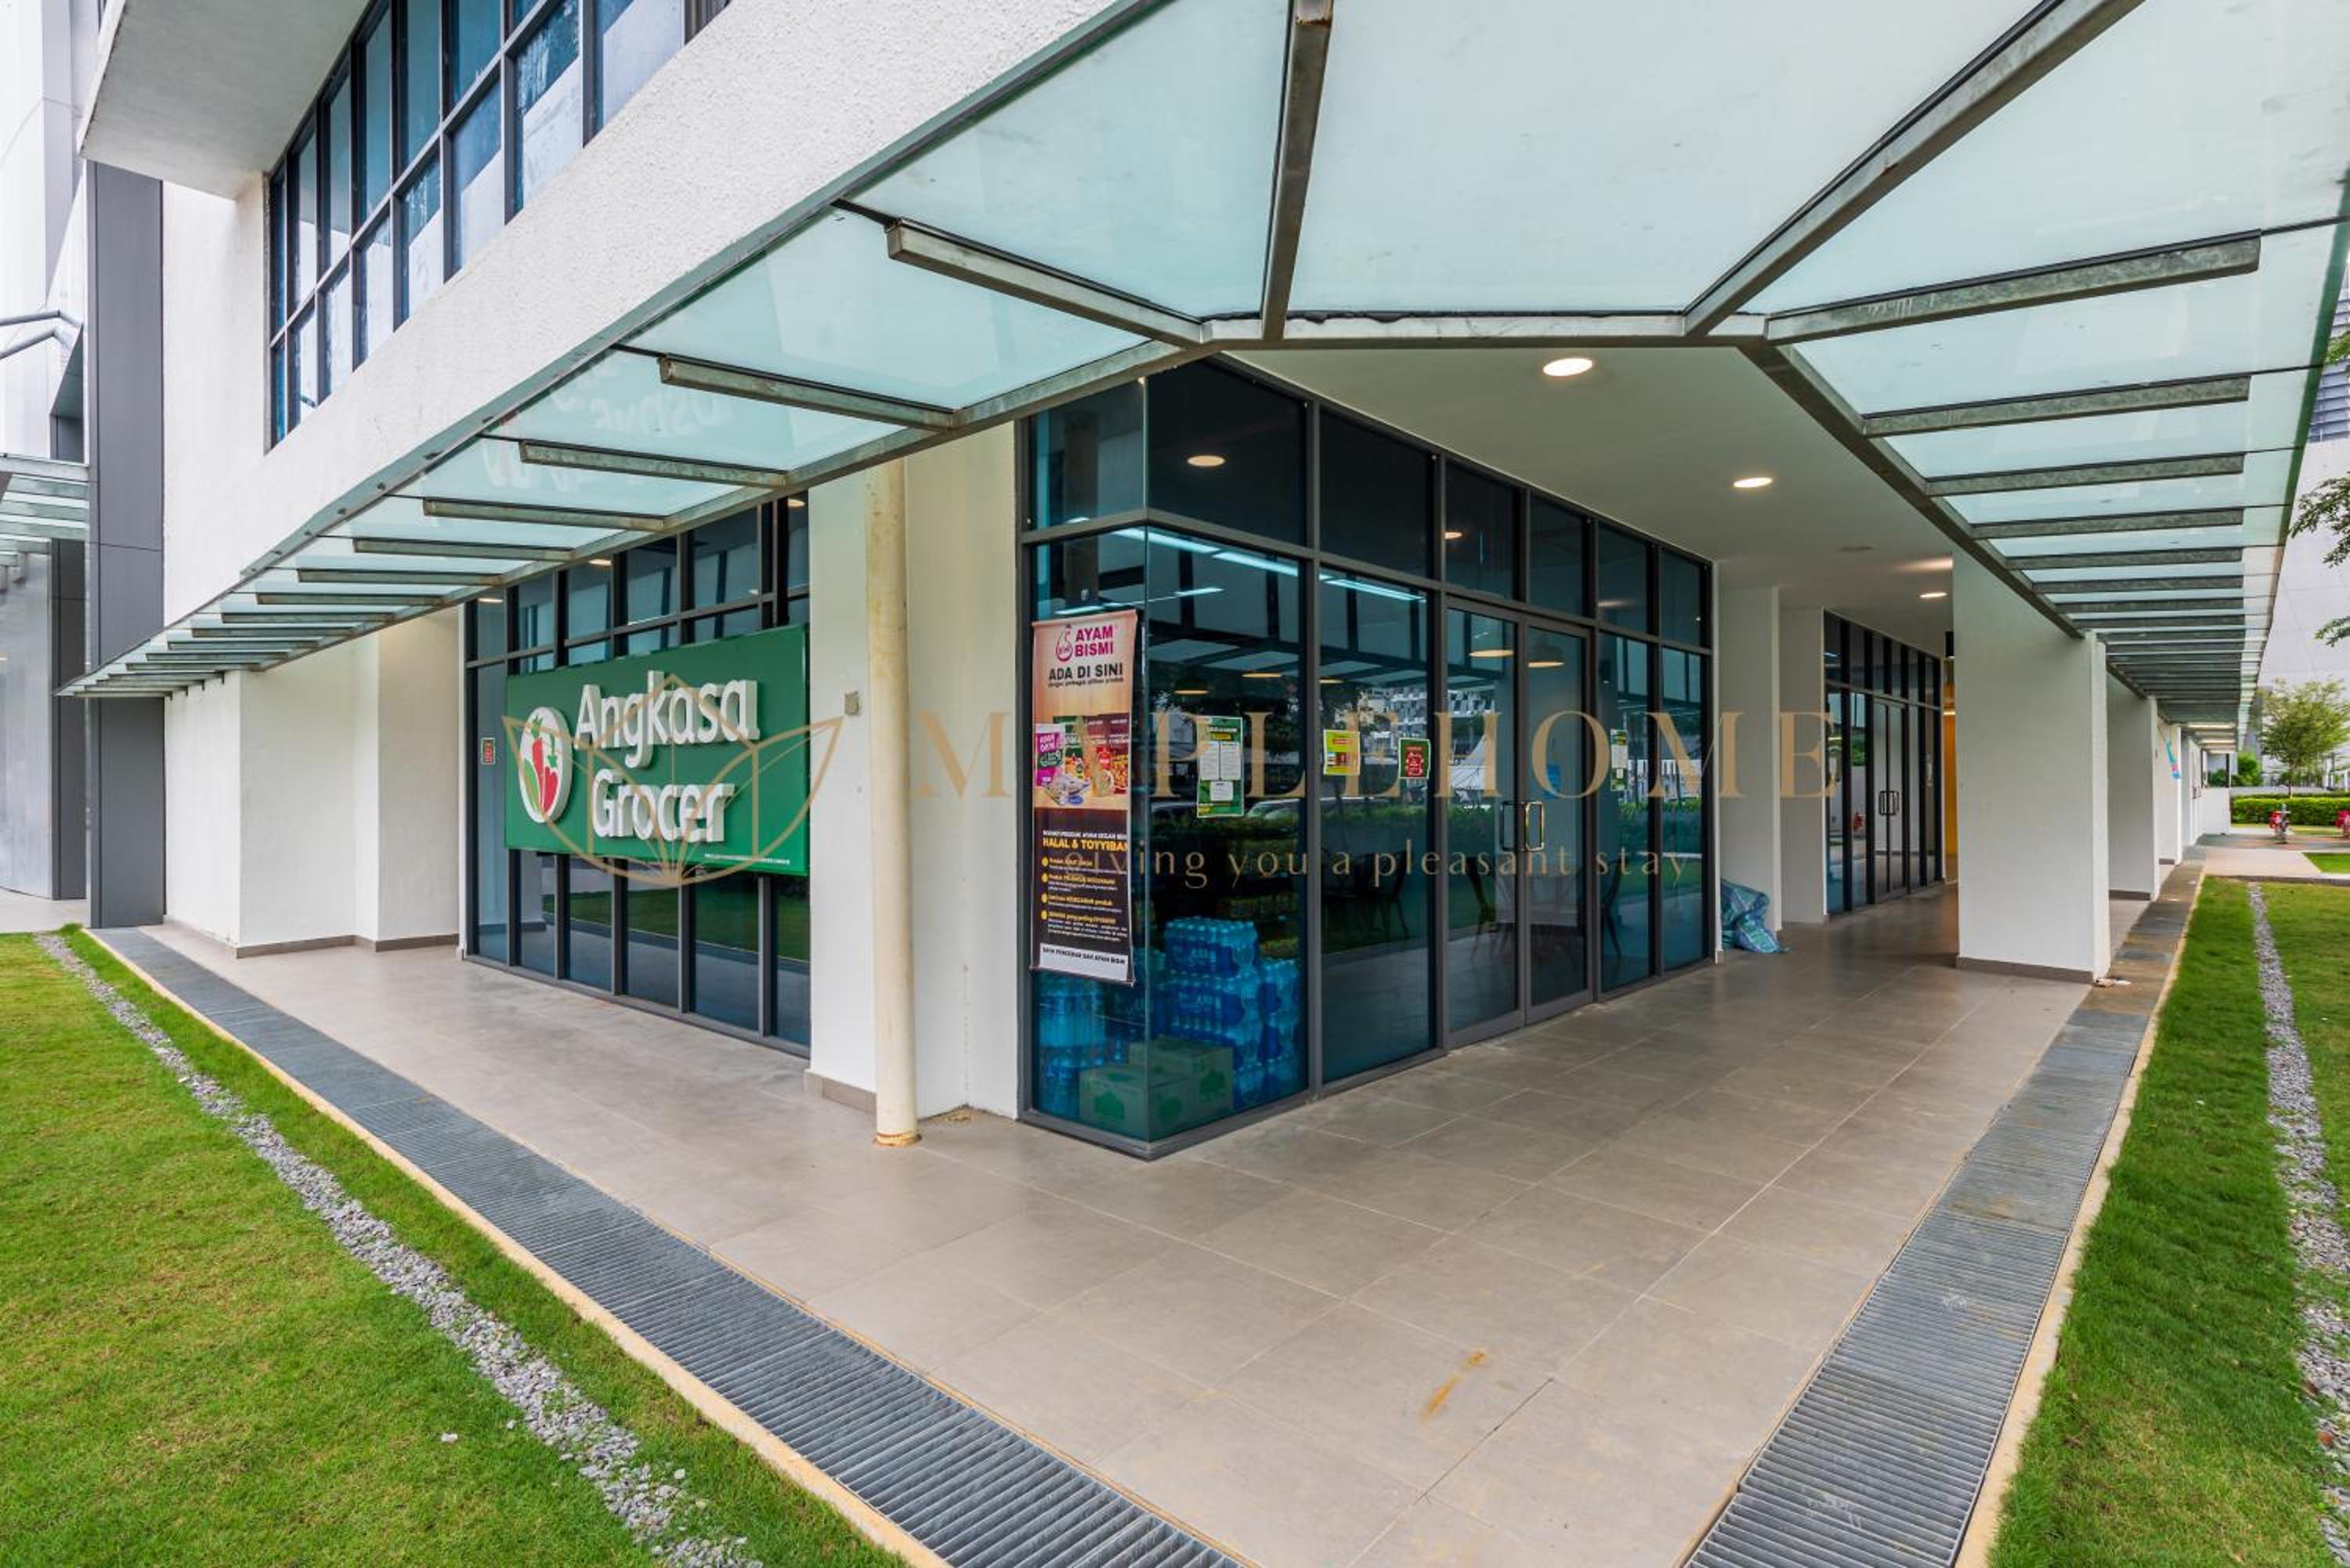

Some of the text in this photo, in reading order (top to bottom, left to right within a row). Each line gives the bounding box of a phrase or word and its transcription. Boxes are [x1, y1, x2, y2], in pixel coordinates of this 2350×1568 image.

[1076, 624, 1114, 642] AYAM
[1074, 641, 1114, 657] BISMI
[1048, 663, 1123, 681] ADA DI SINI
[573, 670, 760, 768] Angkasa
[591, 768, 735, 843] Grocer
[1043, 837, 1070, 848] HALAL
[1071, 839, 1079, 849] &
